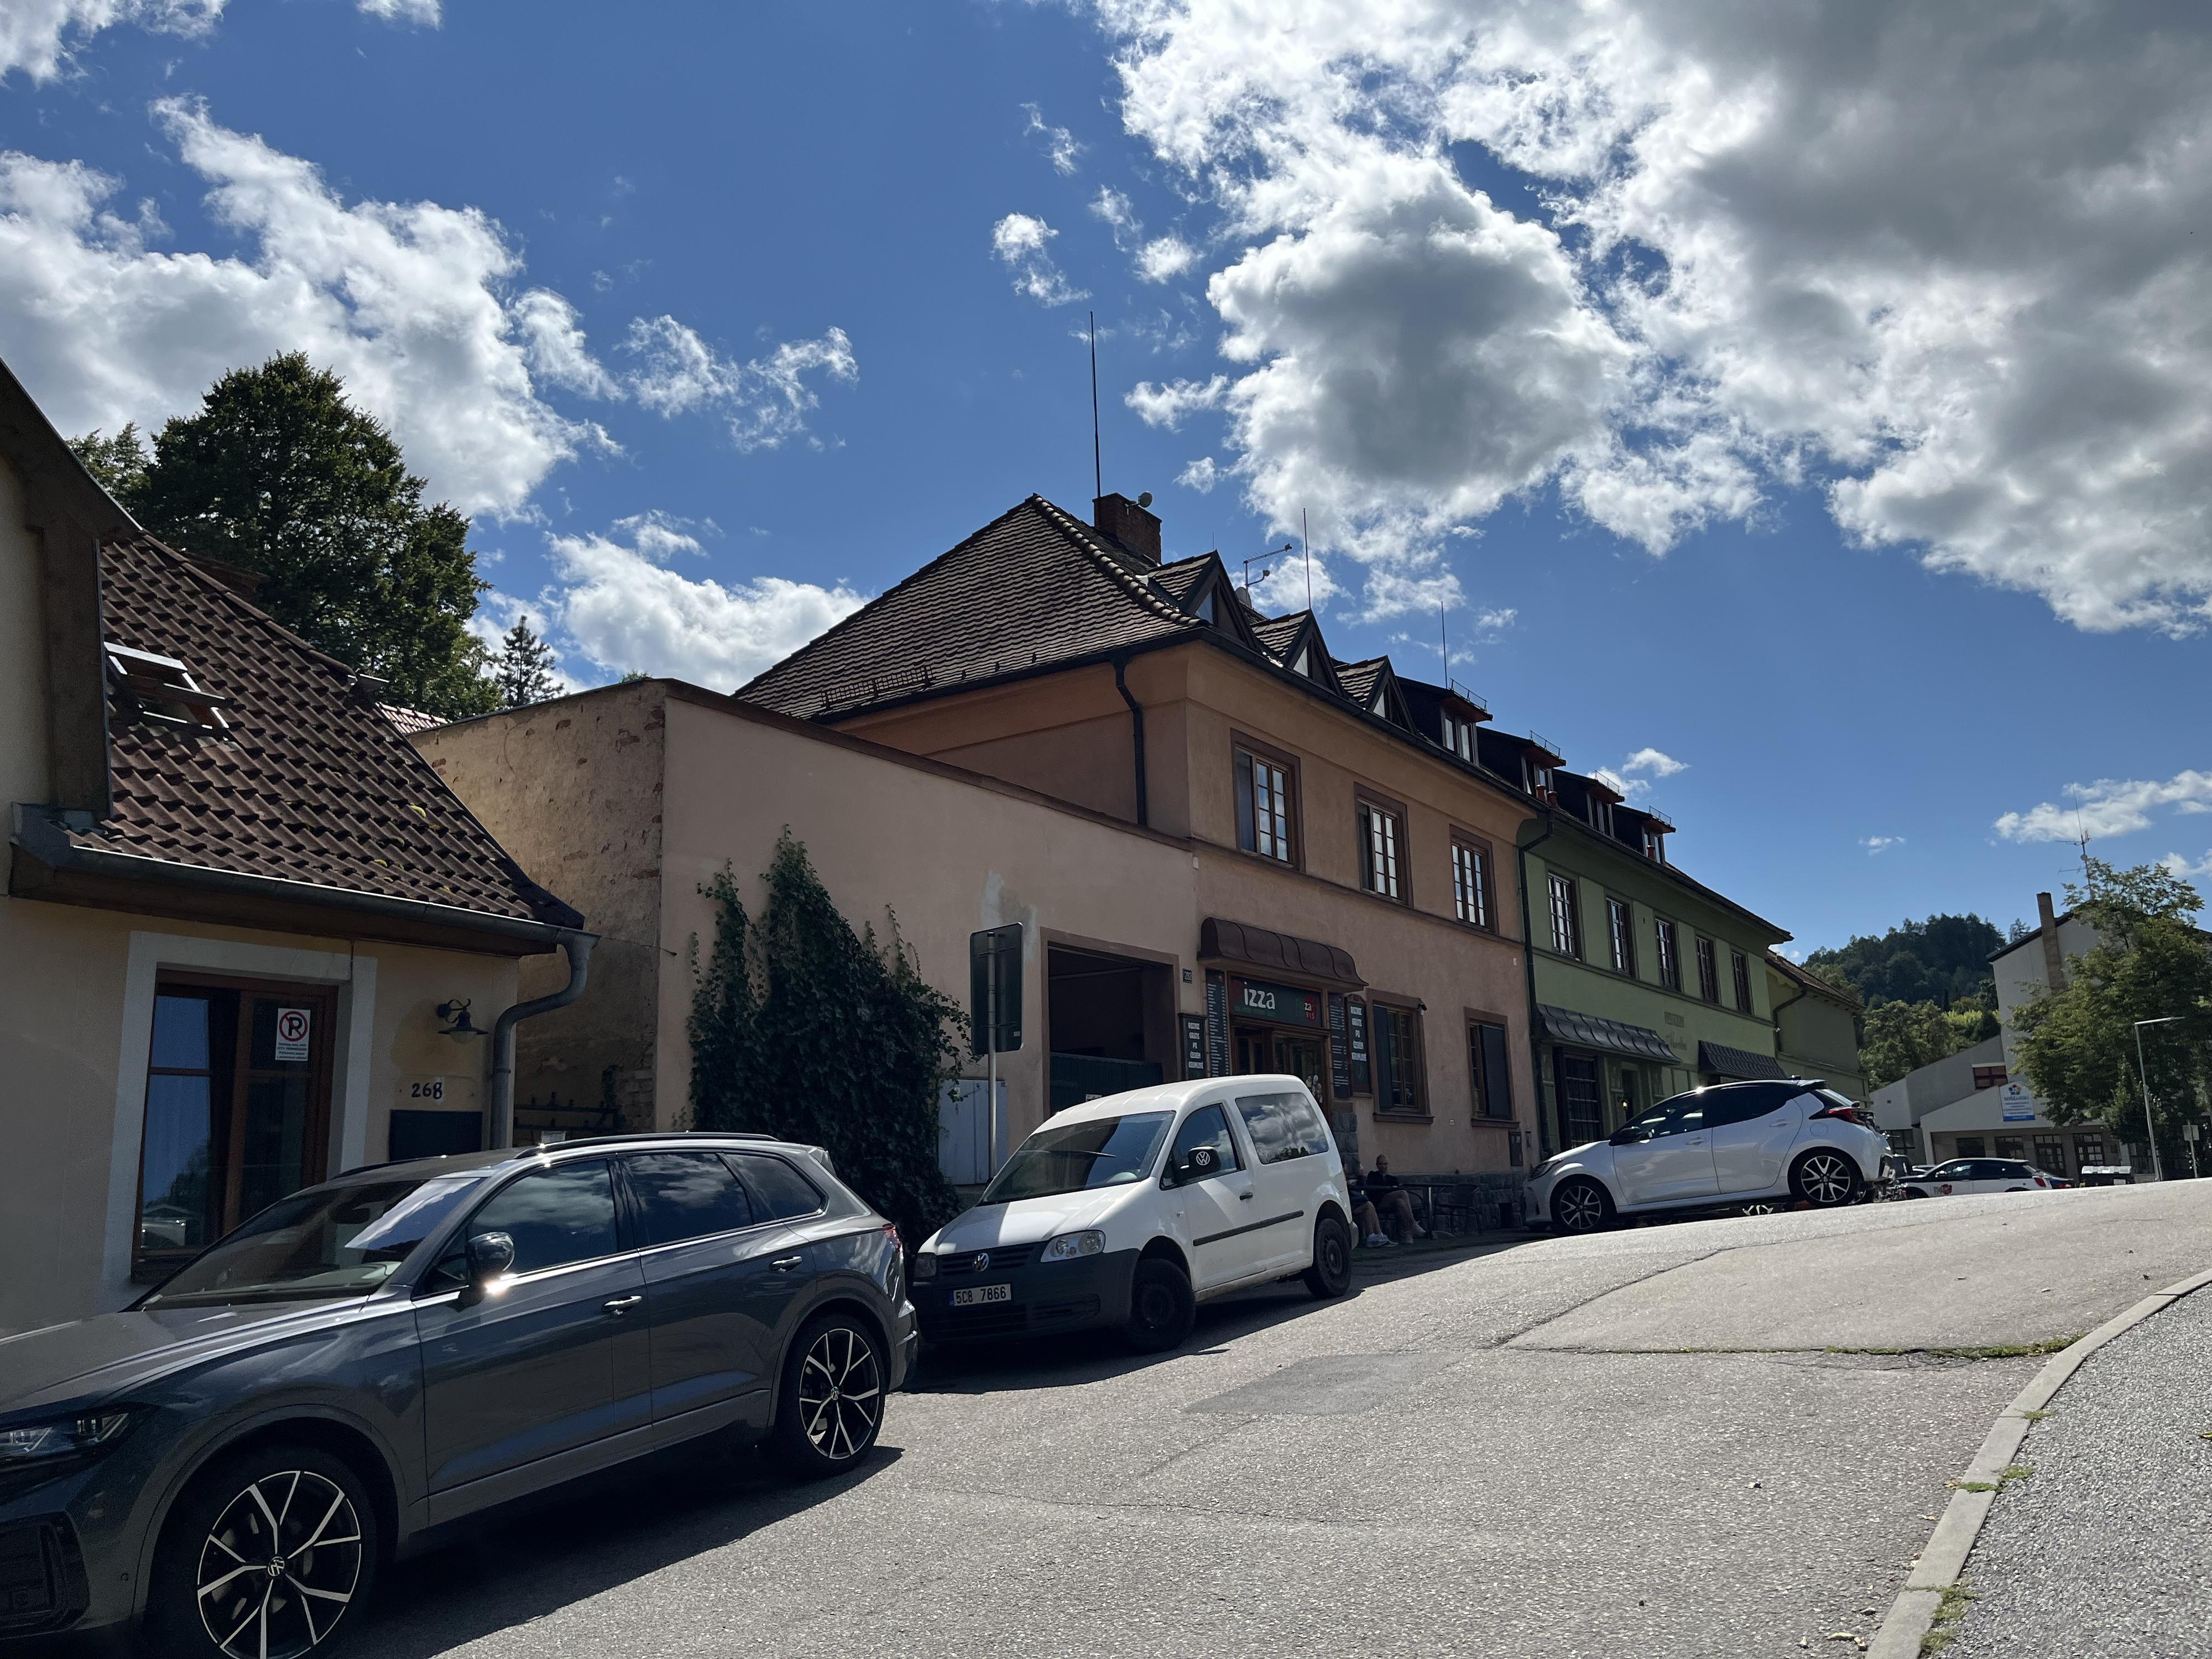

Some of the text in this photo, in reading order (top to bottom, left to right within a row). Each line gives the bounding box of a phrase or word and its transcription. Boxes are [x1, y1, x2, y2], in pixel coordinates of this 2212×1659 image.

[411, 1082, 443, 1099] 268
[956, 1286, 1006, 1304] 5C8 7866
